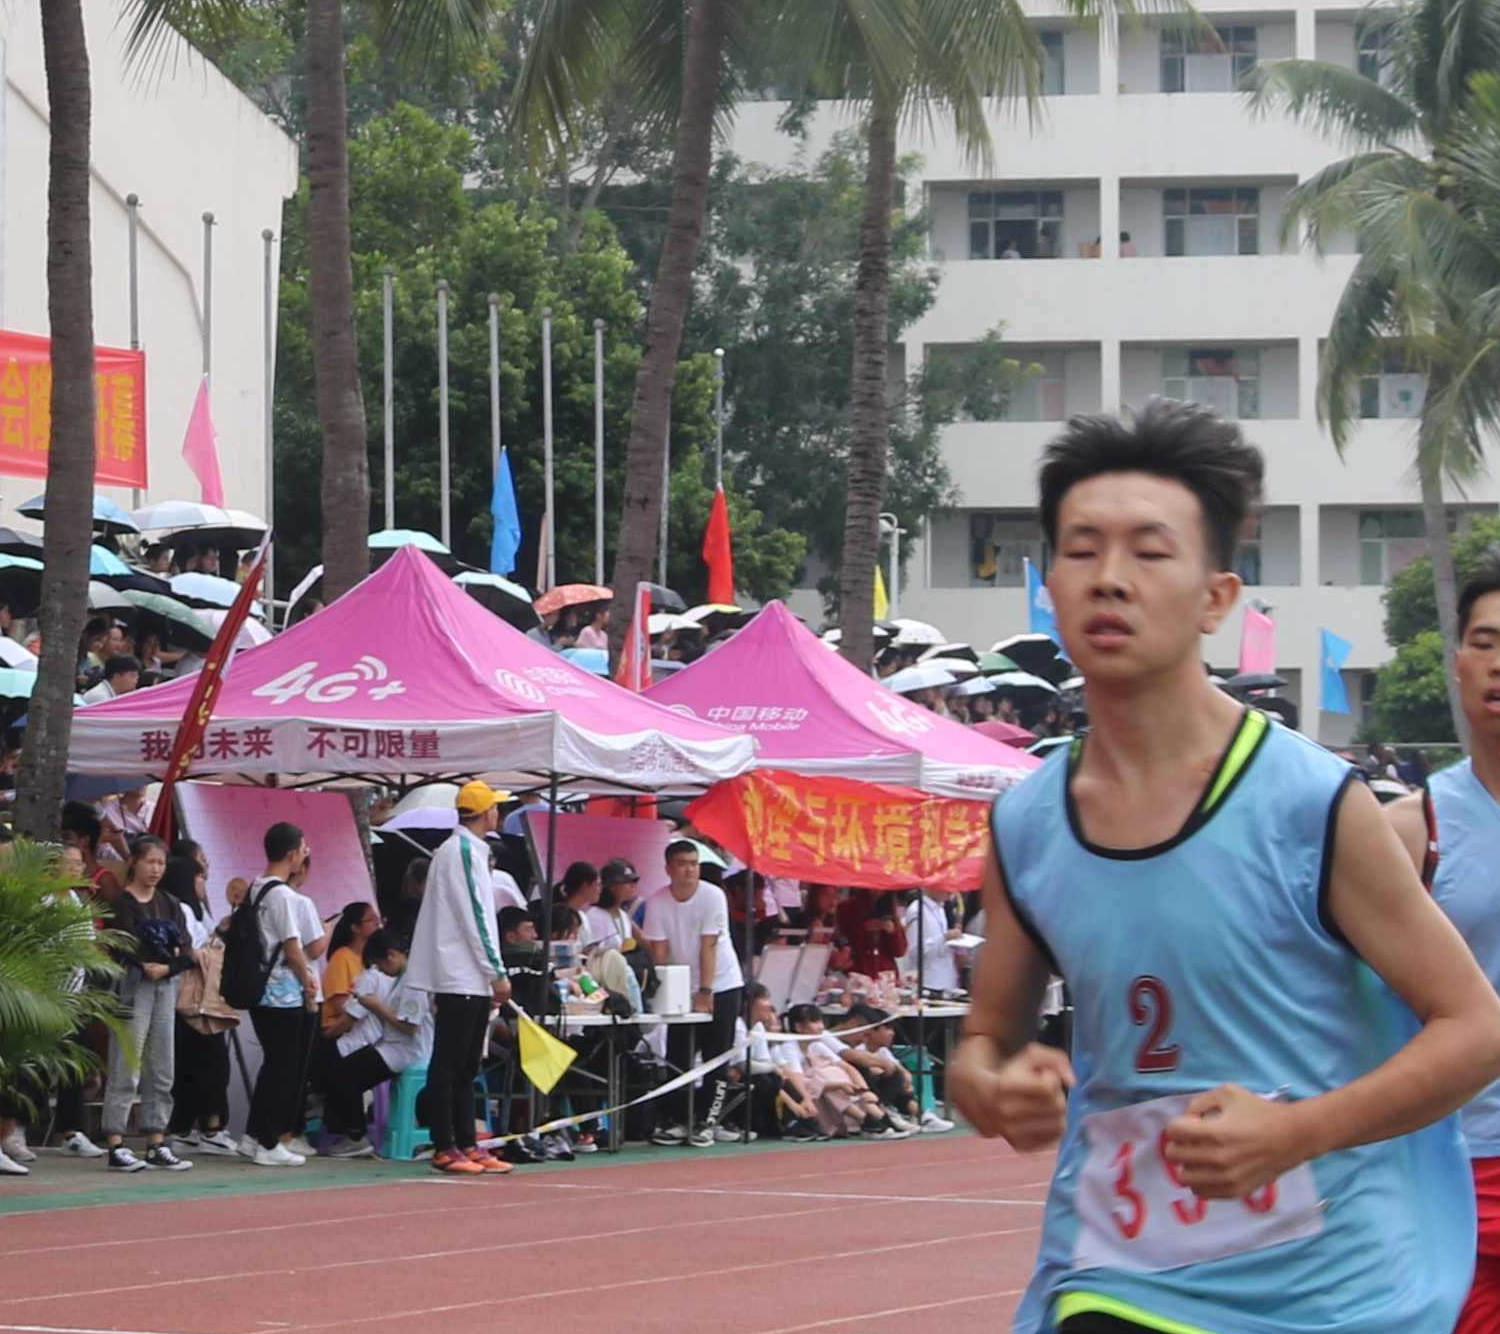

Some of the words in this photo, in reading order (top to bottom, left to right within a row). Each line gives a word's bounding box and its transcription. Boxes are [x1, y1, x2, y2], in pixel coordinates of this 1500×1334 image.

[252, 661, 407, 706] 4G+
[707, 705, 809, 721] 中国移动
[713, 721, 747, 732] hina
[750, 722, 801, 731] Mobile
[306, 727, 442, 759] 不可限量
[1127, 974, 1183, 1075] 2
